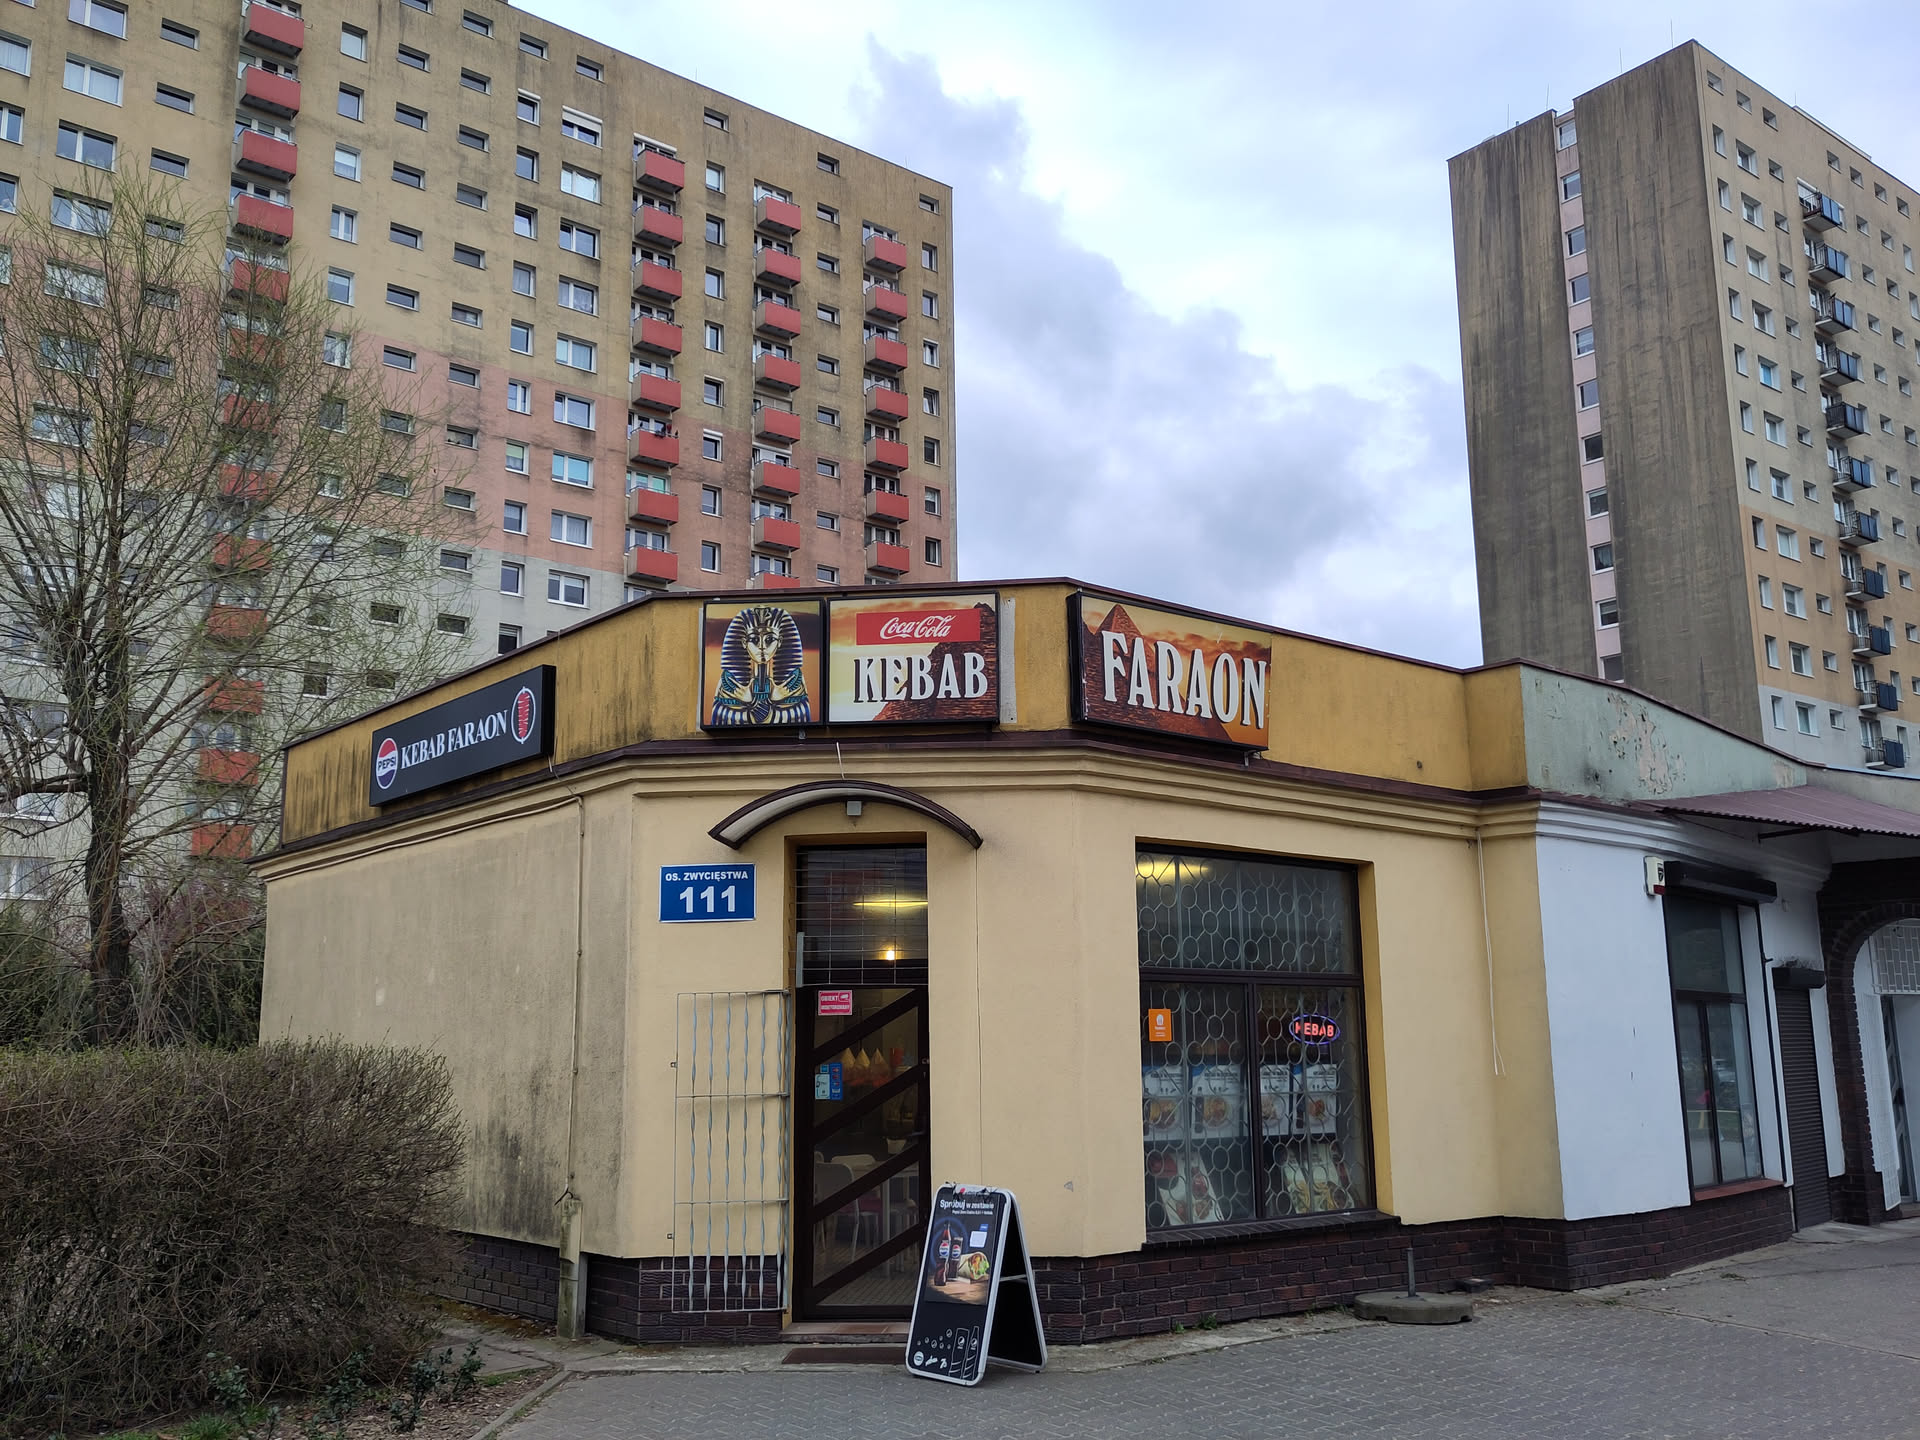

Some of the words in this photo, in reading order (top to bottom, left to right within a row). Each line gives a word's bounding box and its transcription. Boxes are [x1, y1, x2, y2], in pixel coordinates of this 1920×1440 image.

[879, 614, 957, 640] Coca-Cola
[854, 652, 988, 704] KEBAB
[1101, 630, 1266, 729] FARAON
[400, 732, 445, 769] KEBAB
[447, 709, 509, 754] FARAON
[377, 756, 397, 771] PEPSI
[665, 873, 681, 881] OS.
[683, 871, 749, 882] ZWYCIĘSTWA
[680, 885, 736, 913] 111
